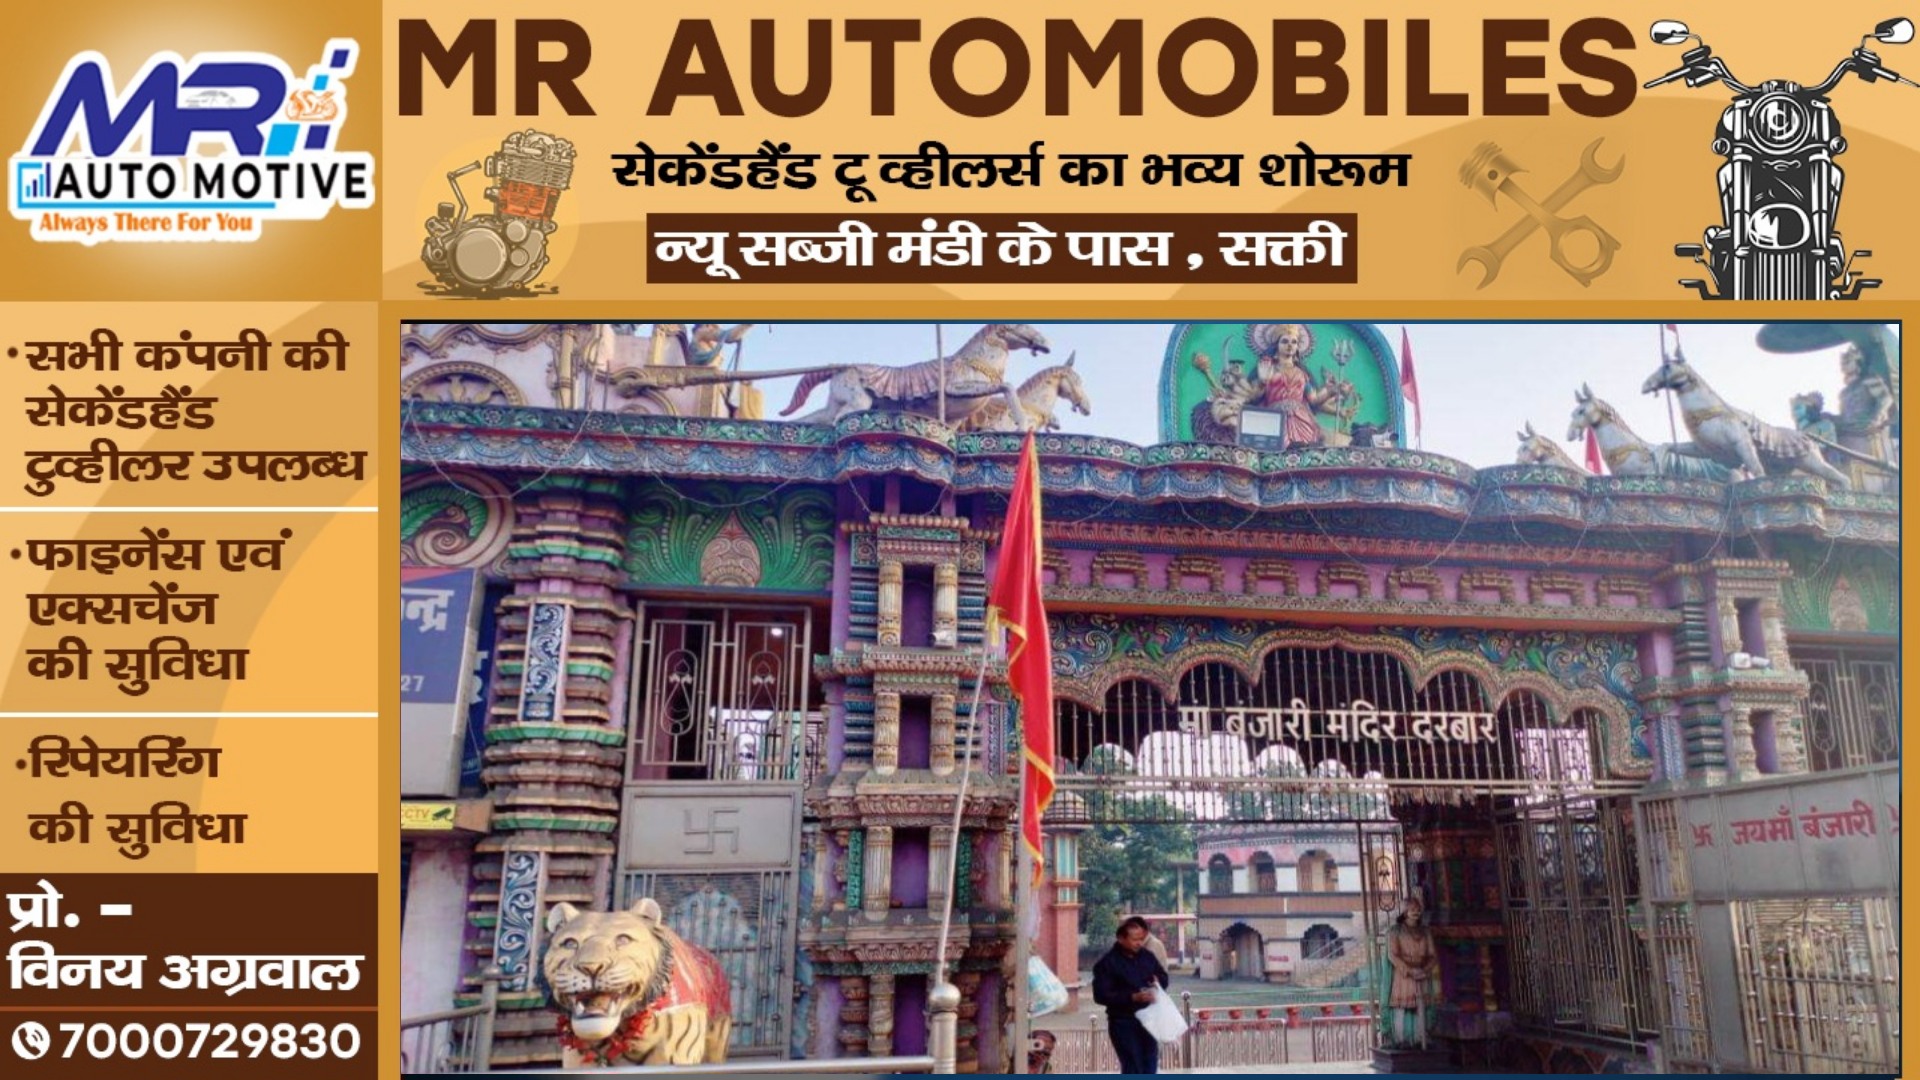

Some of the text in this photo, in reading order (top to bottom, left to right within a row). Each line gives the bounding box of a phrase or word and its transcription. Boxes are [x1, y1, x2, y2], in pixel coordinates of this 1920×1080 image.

[401, 587, 455, 633] न्द्र
[1326, 699, 1397, 743] मंदिर
[1411, 711, 1498, 744] दरबार
[401, 808, 430, 819] CTV
[1798, 798, 1877, 839] बंजारी
